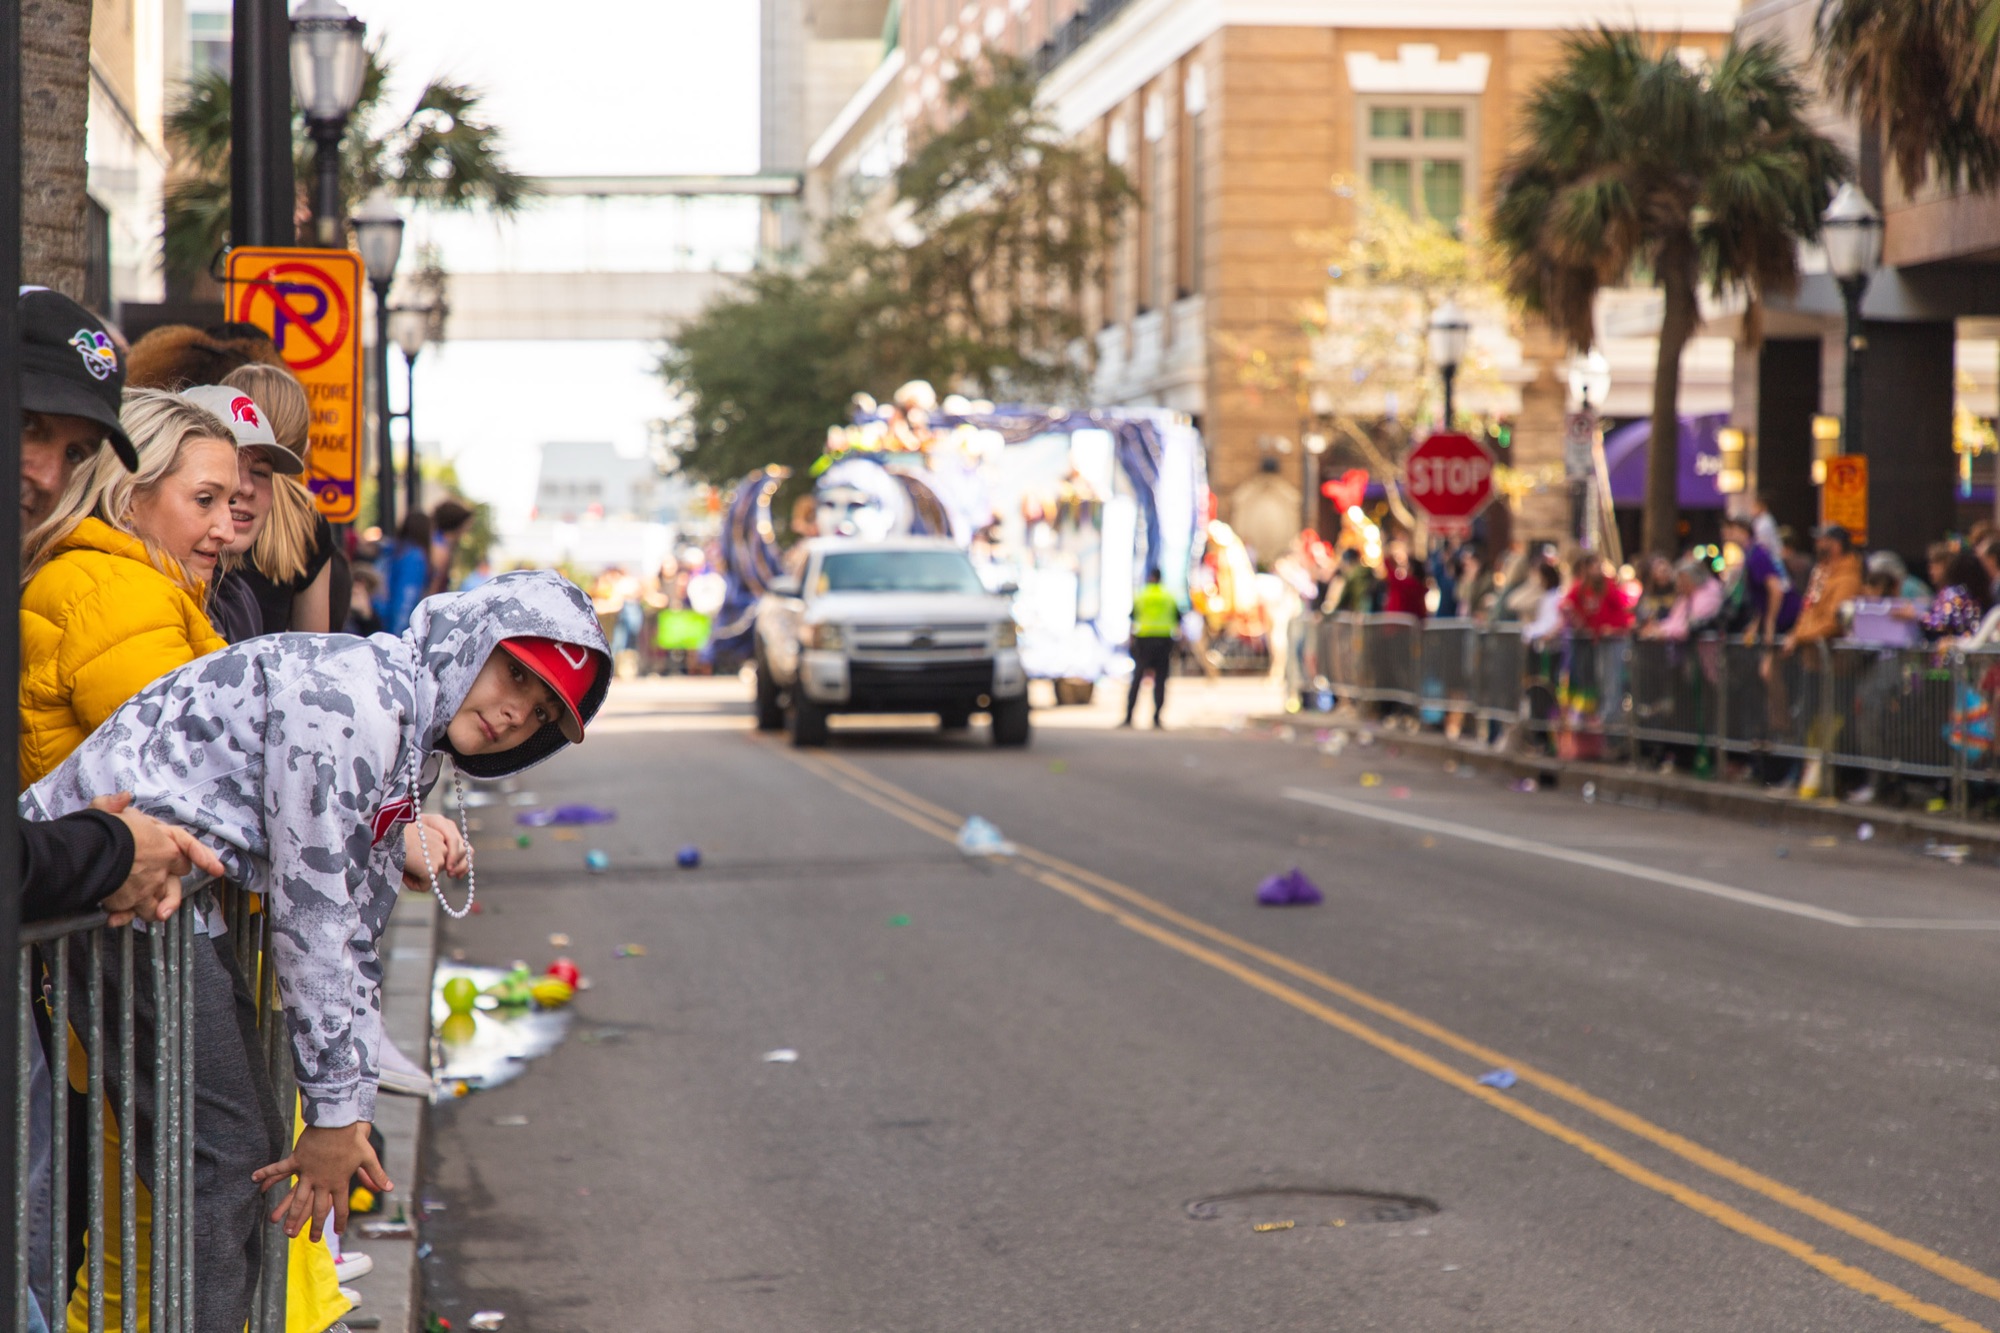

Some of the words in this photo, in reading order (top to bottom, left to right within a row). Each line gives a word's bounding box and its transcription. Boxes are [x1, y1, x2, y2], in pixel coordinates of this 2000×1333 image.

[305, 383, 349, 402] EFORE
[310, 433, 349, 453] RADE
[1411, 456, 1489, 496] STOP
